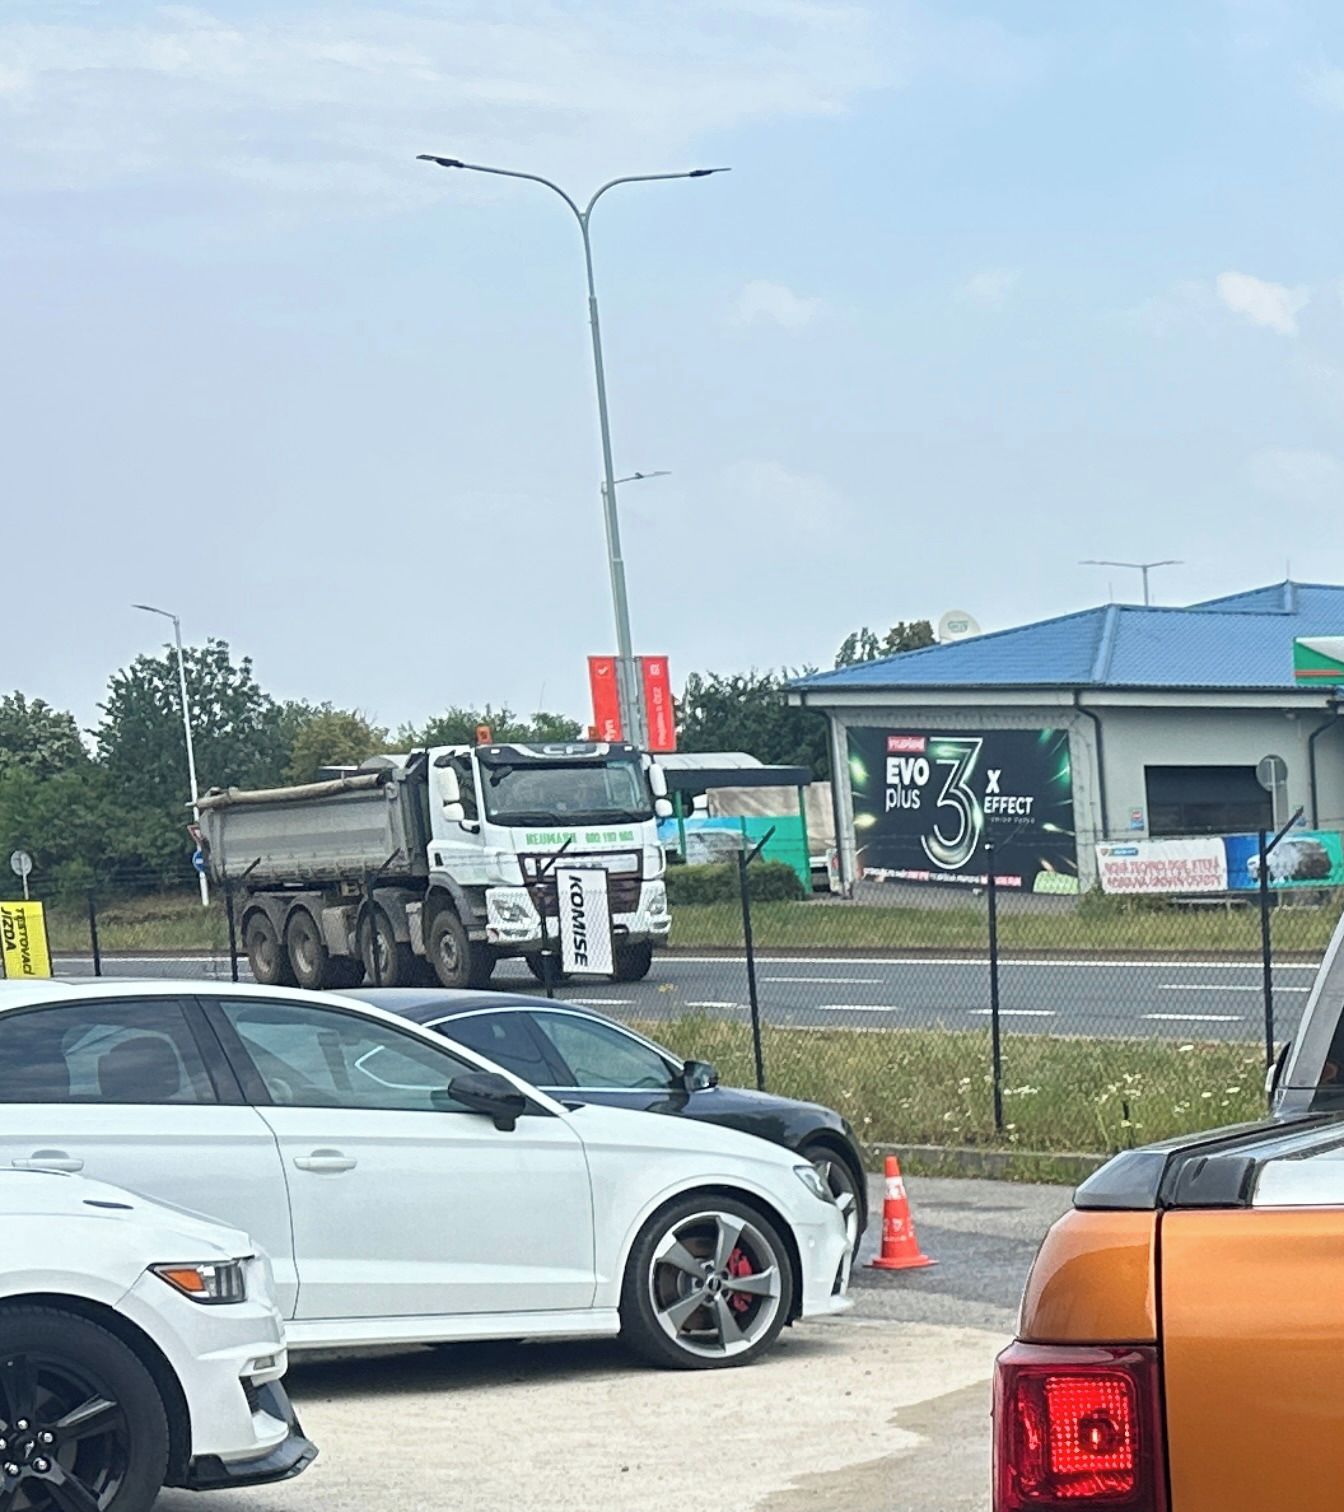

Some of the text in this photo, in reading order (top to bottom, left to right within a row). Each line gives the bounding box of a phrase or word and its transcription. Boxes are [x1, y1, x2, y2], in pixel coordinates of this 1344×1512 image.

[886, 757, 930, 786] EVO
[985, 769, 1001, 794] X
[885, 783, 921, 812] plus
[921, 737, 983, 869] 3
[984, 796, 1033, 815] EFFECT
[568, 875, 588, 967] KOMISE
